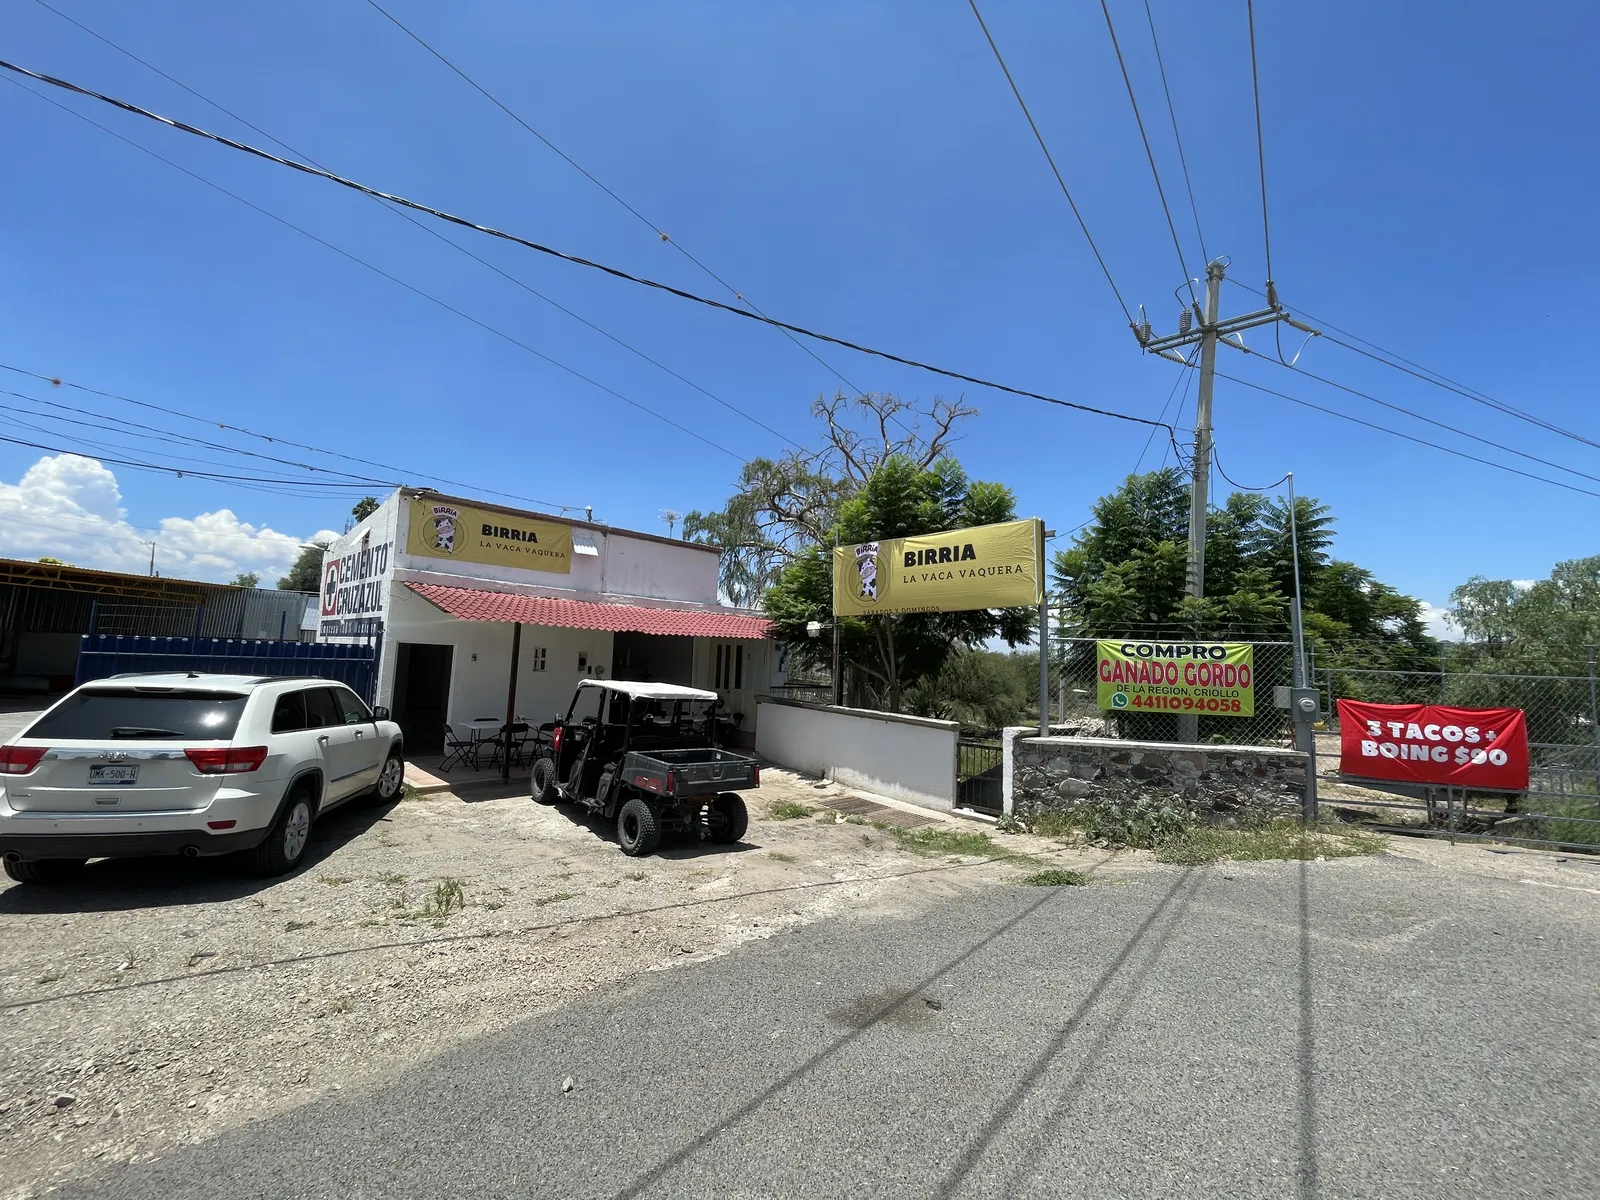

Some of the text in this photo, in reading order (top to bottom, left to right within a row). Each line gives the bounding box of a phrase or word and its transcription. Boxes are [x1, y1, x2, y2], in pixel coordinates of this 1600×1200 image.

[481, 523, 538, 543] BIRRIA
[480, 541, 566, 559] LA VACA VAQUERA
[904, 543, 976, 567] BIRRIA
[340, 542, 388, 584] CEMENTO
[903, 564, 1023, 584] LA VACA VAQUERA
[902, 605, 940, 613] DOMINGOS
[1120, 643, 1227, 660] COMPRO
[1100, 659, 1251, 689] GANADO GORDO
[1116, 684, 1239, 698] DE LA REGION, CRIOLLO
[1132, 695, 1241, 713] 4411094058
[1366, 720, 1382, 737] 3
[1387, 721, 1481, 743] TACOS
[1361, 740, 1508, 766] BOING $90
